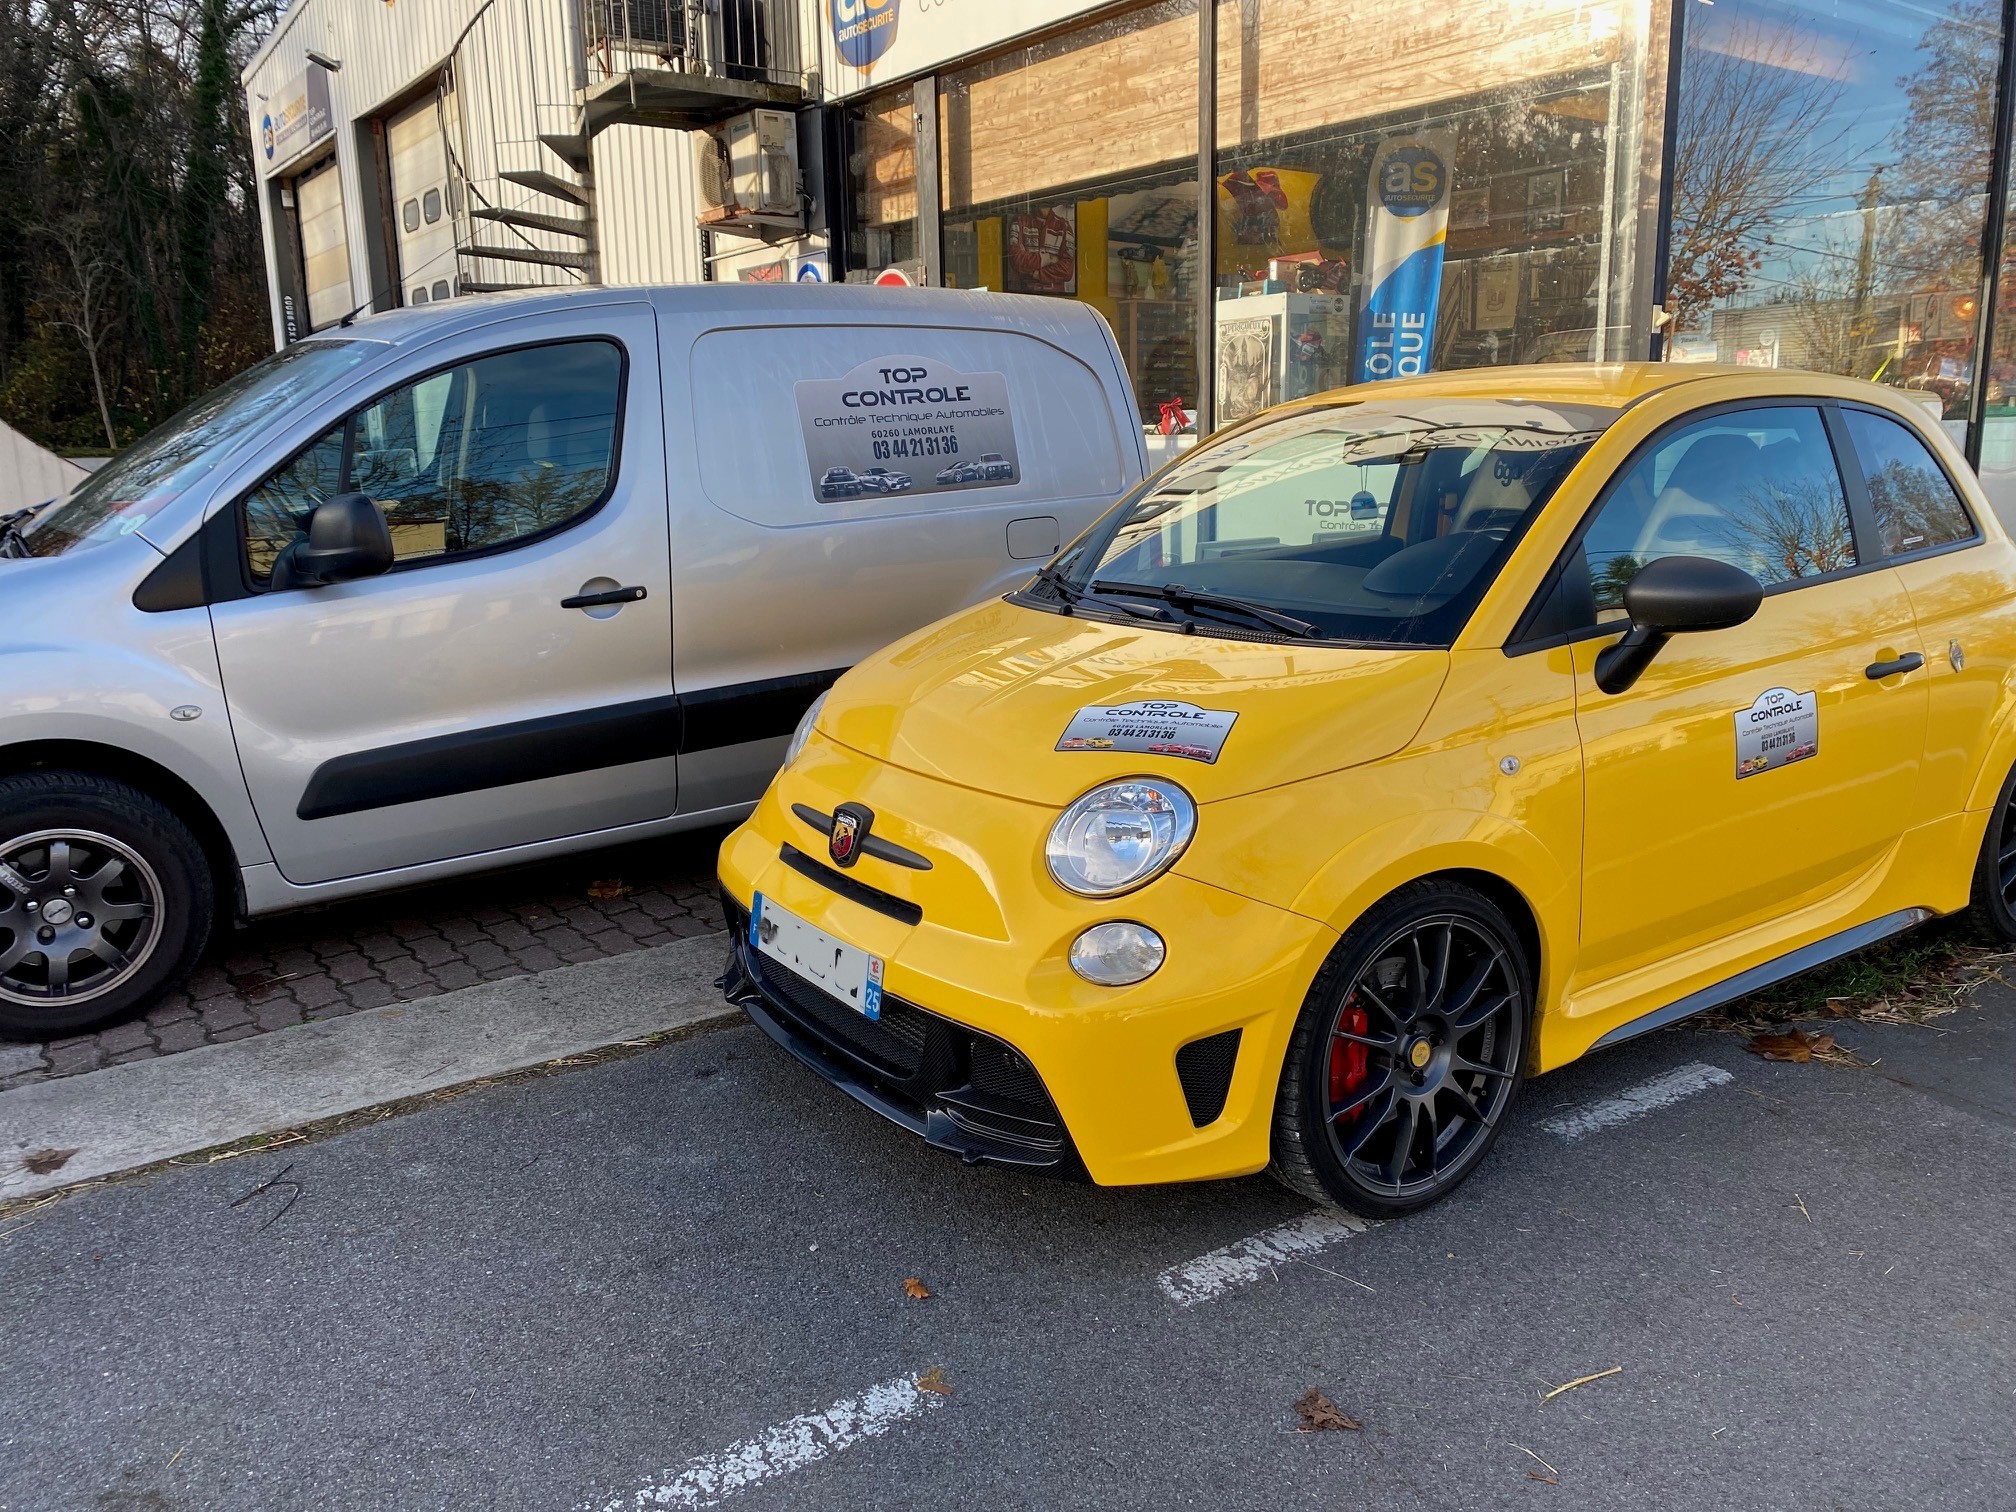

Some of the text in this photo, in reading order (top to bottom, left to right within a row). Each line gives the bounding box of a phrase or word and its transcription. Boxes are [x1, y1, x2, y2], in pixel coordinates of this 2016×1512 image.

[1385, 161, 1438, 193] as
[1398, 312, 1426, 378] QUE
[879, 367, 928, 384] TOP
[842, 386, 971, 408] CONTROLE
[814, 407, 1005, 428] Contrôle Technique Automobiles
[871, 425, 956, 439] 60260 LAMORLAYE
[872, 435, 959, 460] 03 44 21 31 36
[1304, 500, 1351, 517] TOP
[1320, 520, 1366, 531] Contrôle
[1765, 693, 1785, 705] TOP
[1105, 709, 1207, 719] CONTROLE
[1751, 700, 1803, 723] CONTROLE
[1169, 721, 1224, 729] Automobile
[1107, 729, 1176, 740] 03 44 21 31 36
[866, 987, 880, 1013] 25
